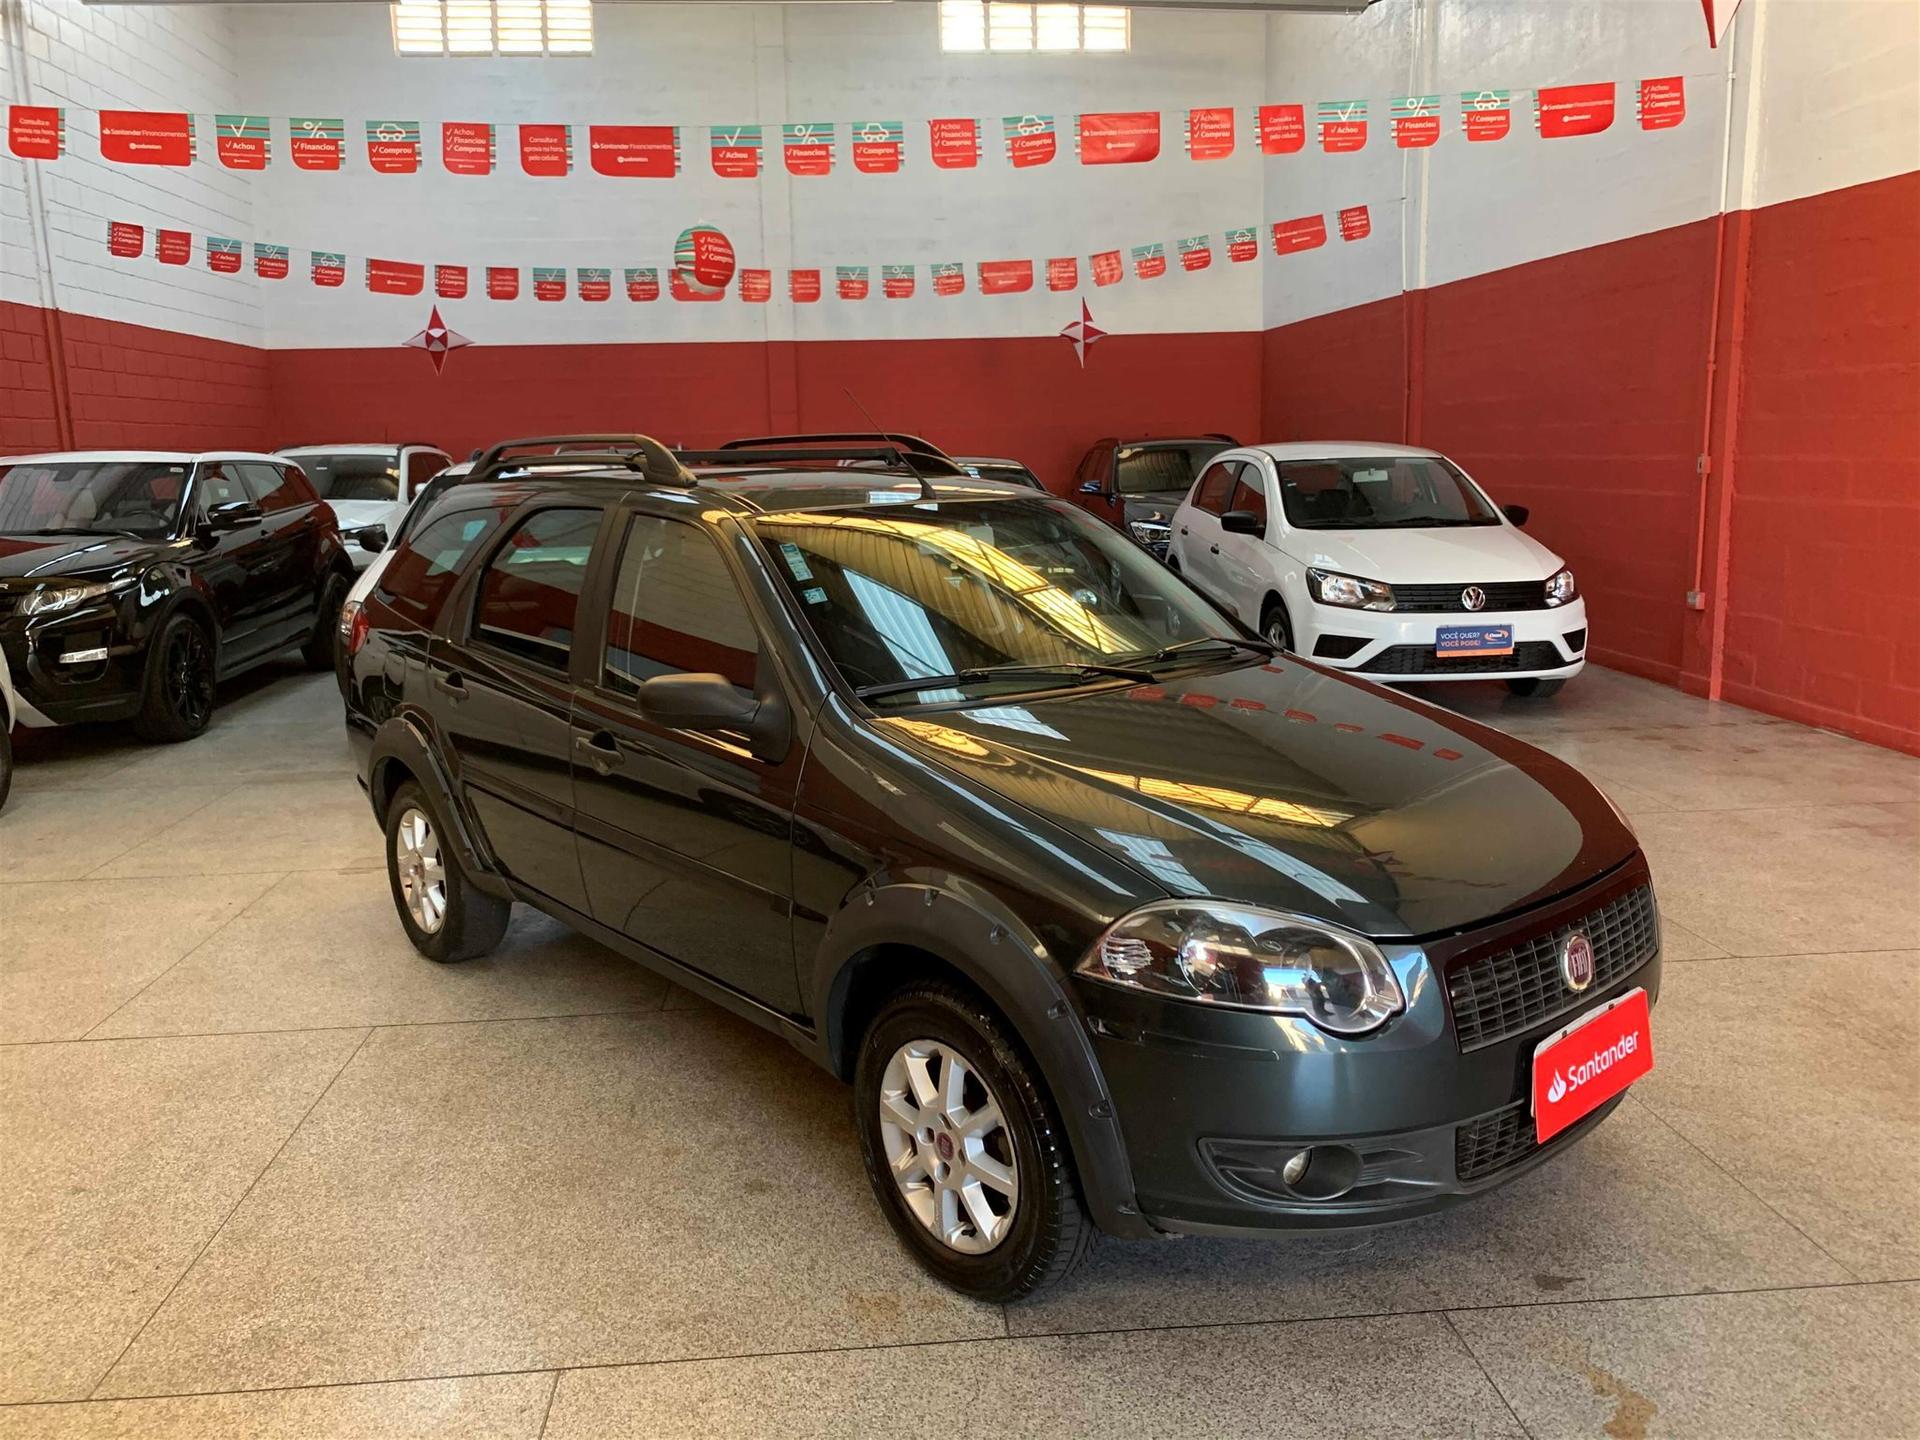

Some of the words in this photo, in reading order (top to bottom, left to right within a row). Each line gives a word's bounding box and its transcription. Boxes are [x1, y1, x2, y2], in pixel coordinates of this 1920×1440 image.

[1475, 114, 1506, 123] Comprou
[1404, 121, 1436, 129] Financiou
[111, 128, 142, 136] Santander
[454, 128, 474, 136] Achou
[1337, 126, 1358, 134] Achou
[454, 136, 486, 144] Financiou
[1021, 138, 1052, 148] Comprou
[232, 142, 256, 150] Achou
[300, 142, 336, 151] Financiou
[454, 145, 486, 154] Comprou
[378, 146, 412, 155] Comprou
[792, 149, 826, 157] Financiou
[862, 146, 894, 156] Comprou
[726, 151, 748, 159] Achou
[1440, 632, 1458, 640] VOCÊ
[1571, 950, 1588, 977] FIAT
[1567, 1030, 1639, 1092] Santander
